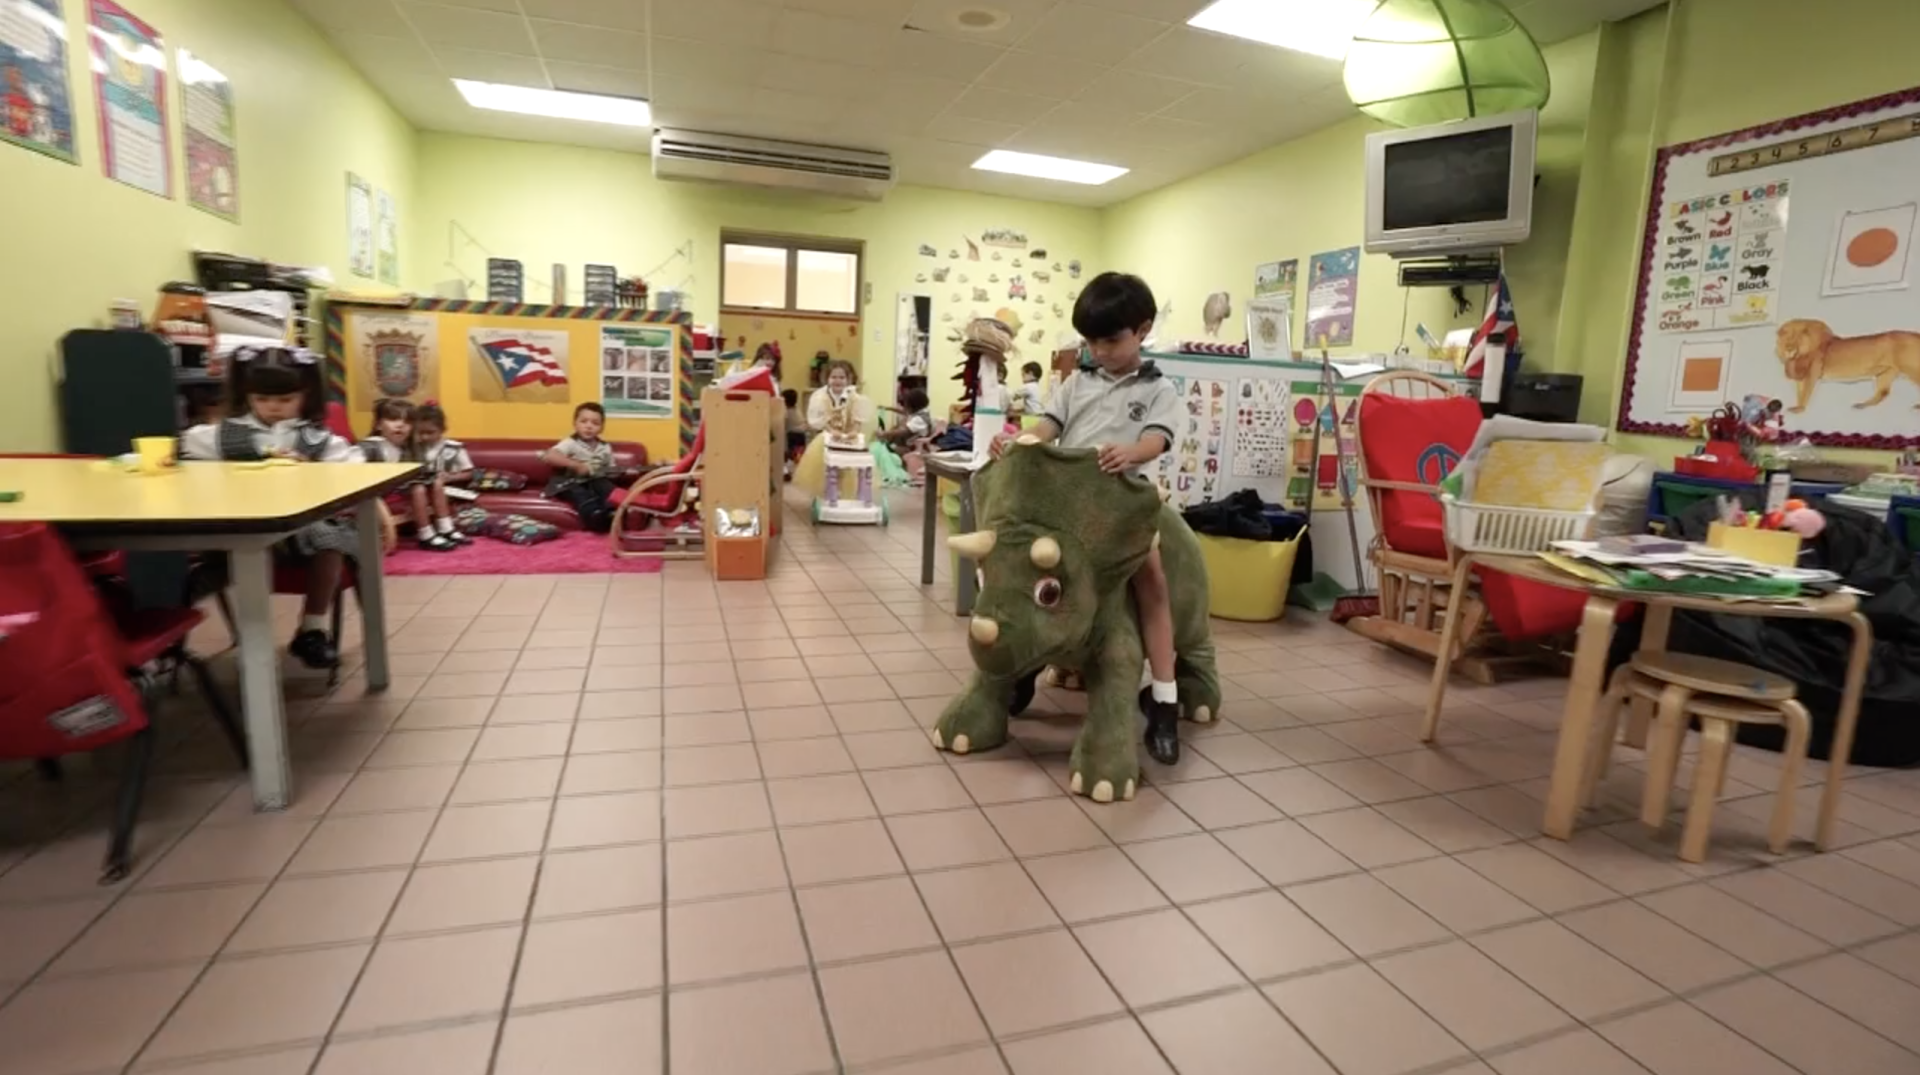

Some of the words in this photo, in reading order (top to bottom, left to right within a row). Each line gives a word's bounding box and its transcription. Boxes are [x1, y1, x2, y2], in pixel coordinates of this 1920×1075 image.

[1751, 153, 1760, 165] 3
[1771, 148, 1781, 160] 4
[1798, 142, 1808, 155] 5
[1868, 128, 1880, 141] 7
[1670, 197, 1716, 218] ASIC
[1719, 181, 1789, 206] CLORS
[1708, 226, 1733, 239] Red
[1666, 233, 1702, 246] Brown
[1741, 248, 1774, 260] Gray
[1664, 259, 1699, 271] Purple
[1704, 261, 1730, 272] Blue
[1737, 279, 1770, 292] Black
[1661, 290, 1695, 301] Green
[1701, 295, 1725, 306] Pink
[1659, 319, 1700, 331] Orange
